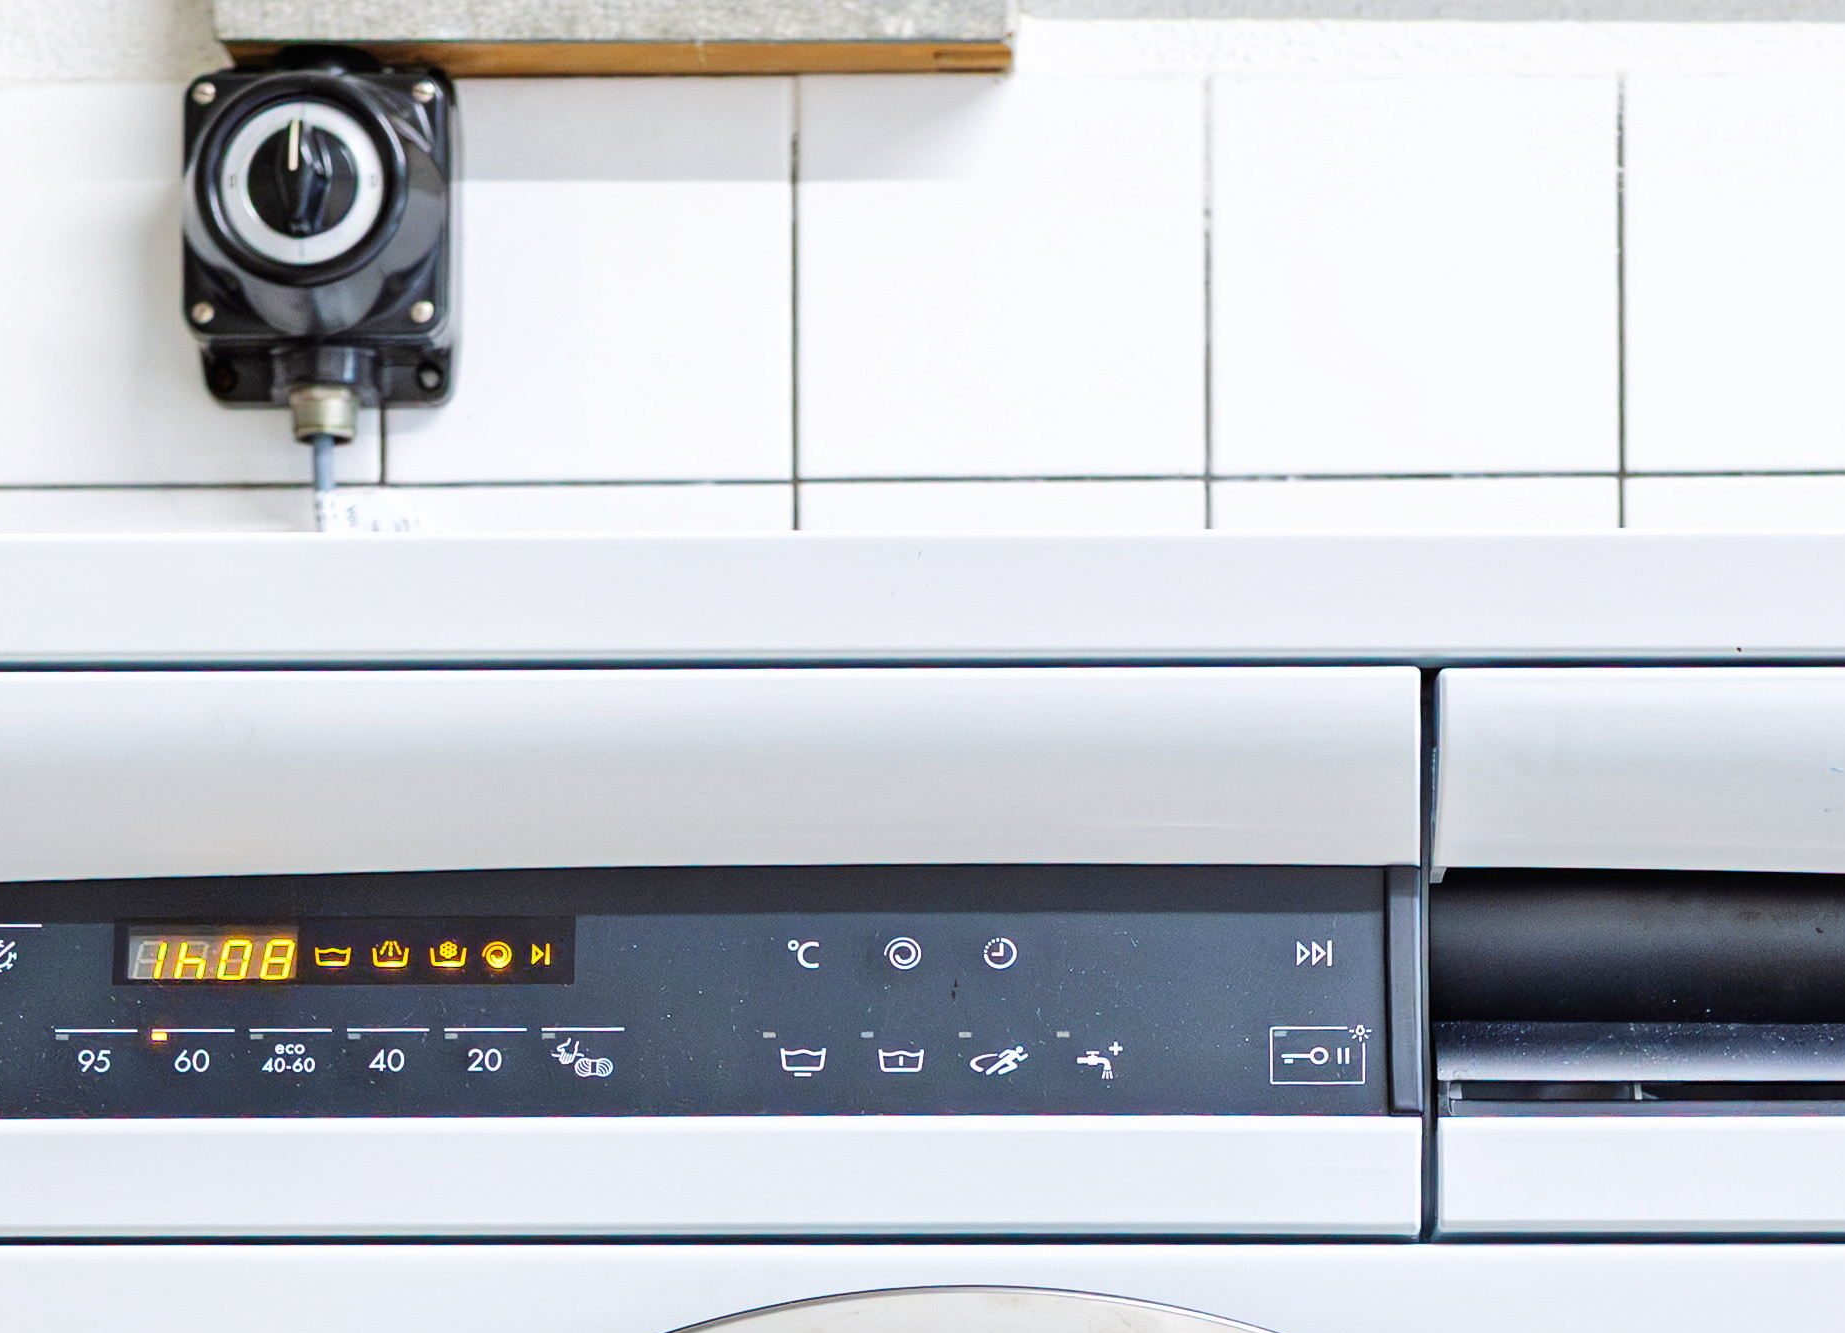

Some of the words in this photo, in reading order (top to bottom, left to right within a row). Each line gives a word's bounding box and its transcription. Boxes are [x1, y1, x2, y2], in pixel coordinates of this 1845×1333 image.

[152, 937, 296, 981] 1h08
[77, 1049, 112, 1074] 95
[173, 1048, 210, 1073] 60
[274, 1043, 306, 1055] eco
[368, 1048, 405, 1073] 40
[467, 1047, 503, 1072] 20
[261, 1056, 316, 1074] 40-60
